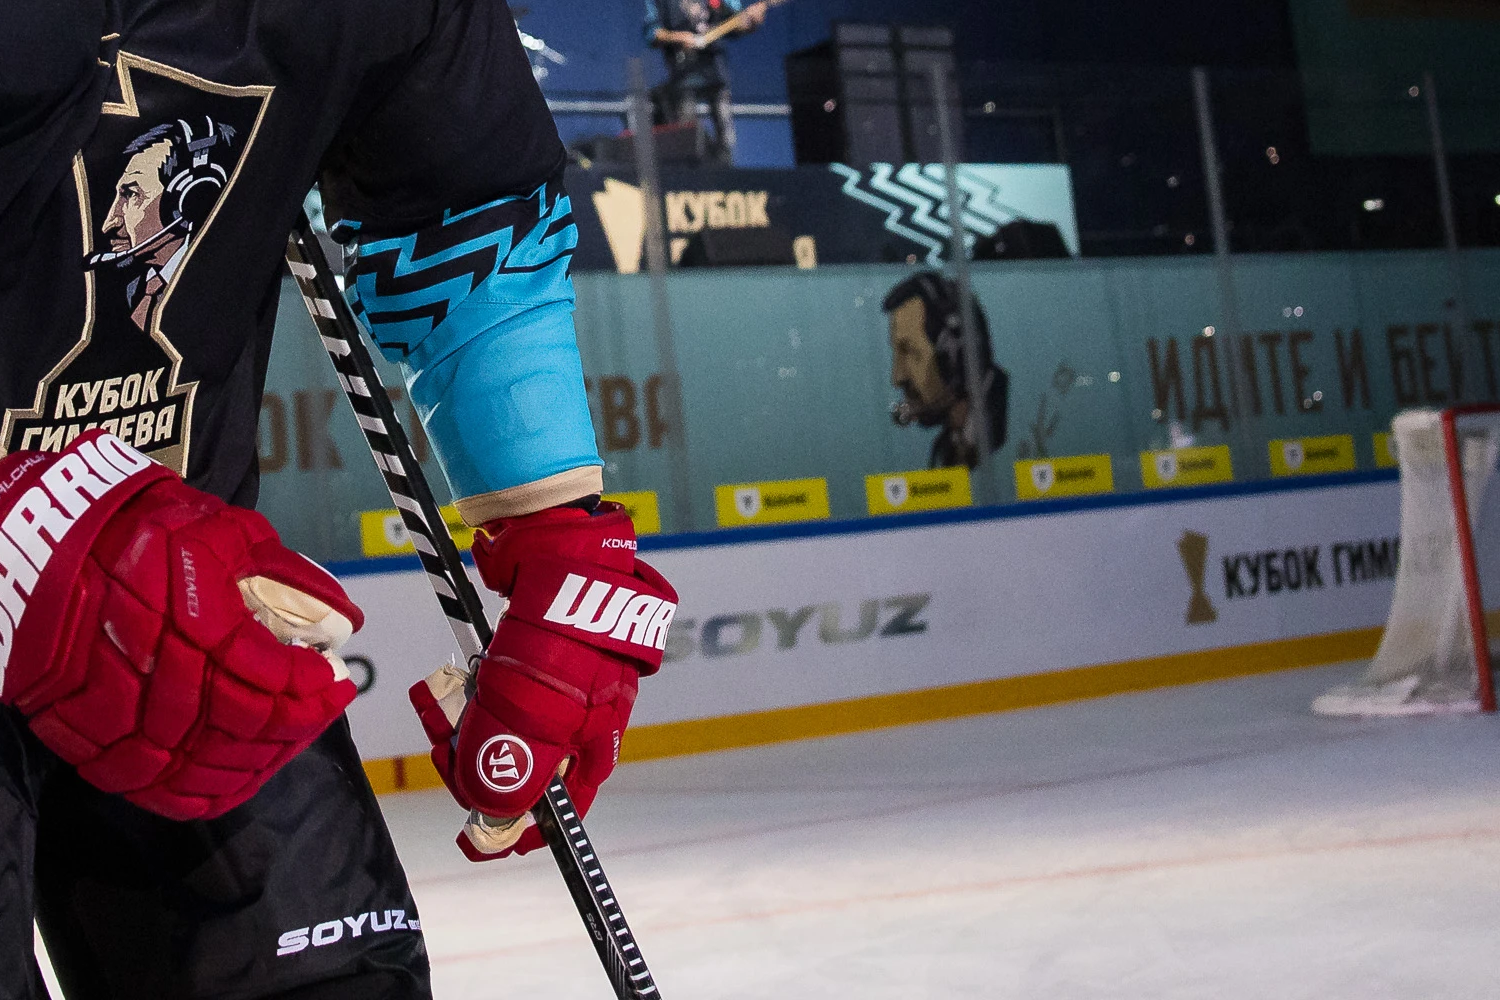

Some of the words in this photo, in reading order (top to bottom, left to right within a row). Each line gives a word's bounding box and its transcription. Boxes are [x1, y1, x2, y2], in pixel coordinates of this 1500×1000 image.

[665, 190, 770, 234] КУБОК
[54, 367, 165, 420] КУБОК
[1334, 327, 1371, 411] И
[1222, 545, 1324, 600] КУБОК
[543, 572, 678, 651] WAR
[276, 909, 408, 957] SOYUZ
